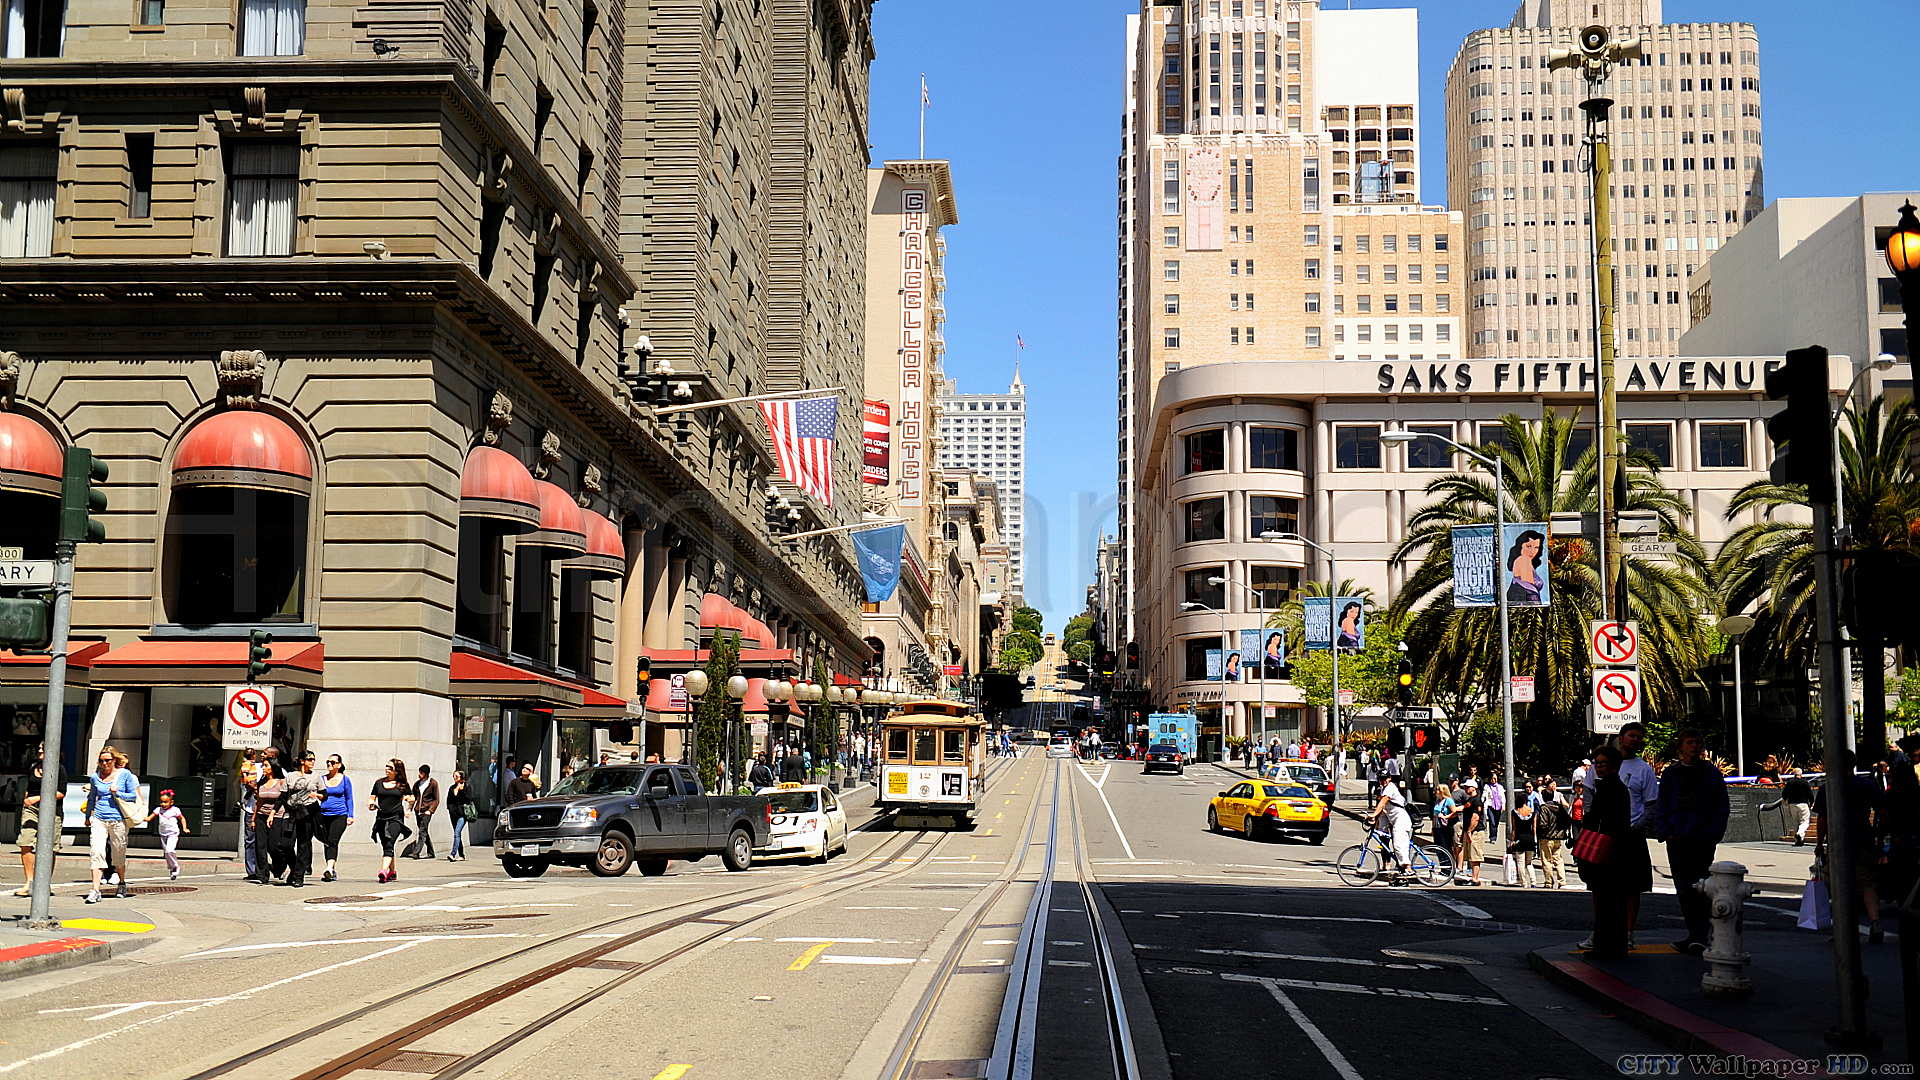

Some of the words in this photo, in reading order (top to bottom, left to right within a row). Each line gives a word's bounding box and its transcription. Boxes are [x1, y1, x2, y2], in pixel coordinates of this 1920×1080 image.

[903, 192, 924, 389] CHANCELLOR
[1377, 363, 1473, 393] SAKS
[1494, 362, 1596, 392] FIFTH
[902, 401, 921, 499] HOTEL
[1631, 544, 1667, 552] GEARY
[1454, 553, 1497, 568] AWARDS
[1454, 567, 1495, 587] NIGHT
[1413, 711, 1428, 719] WAY
